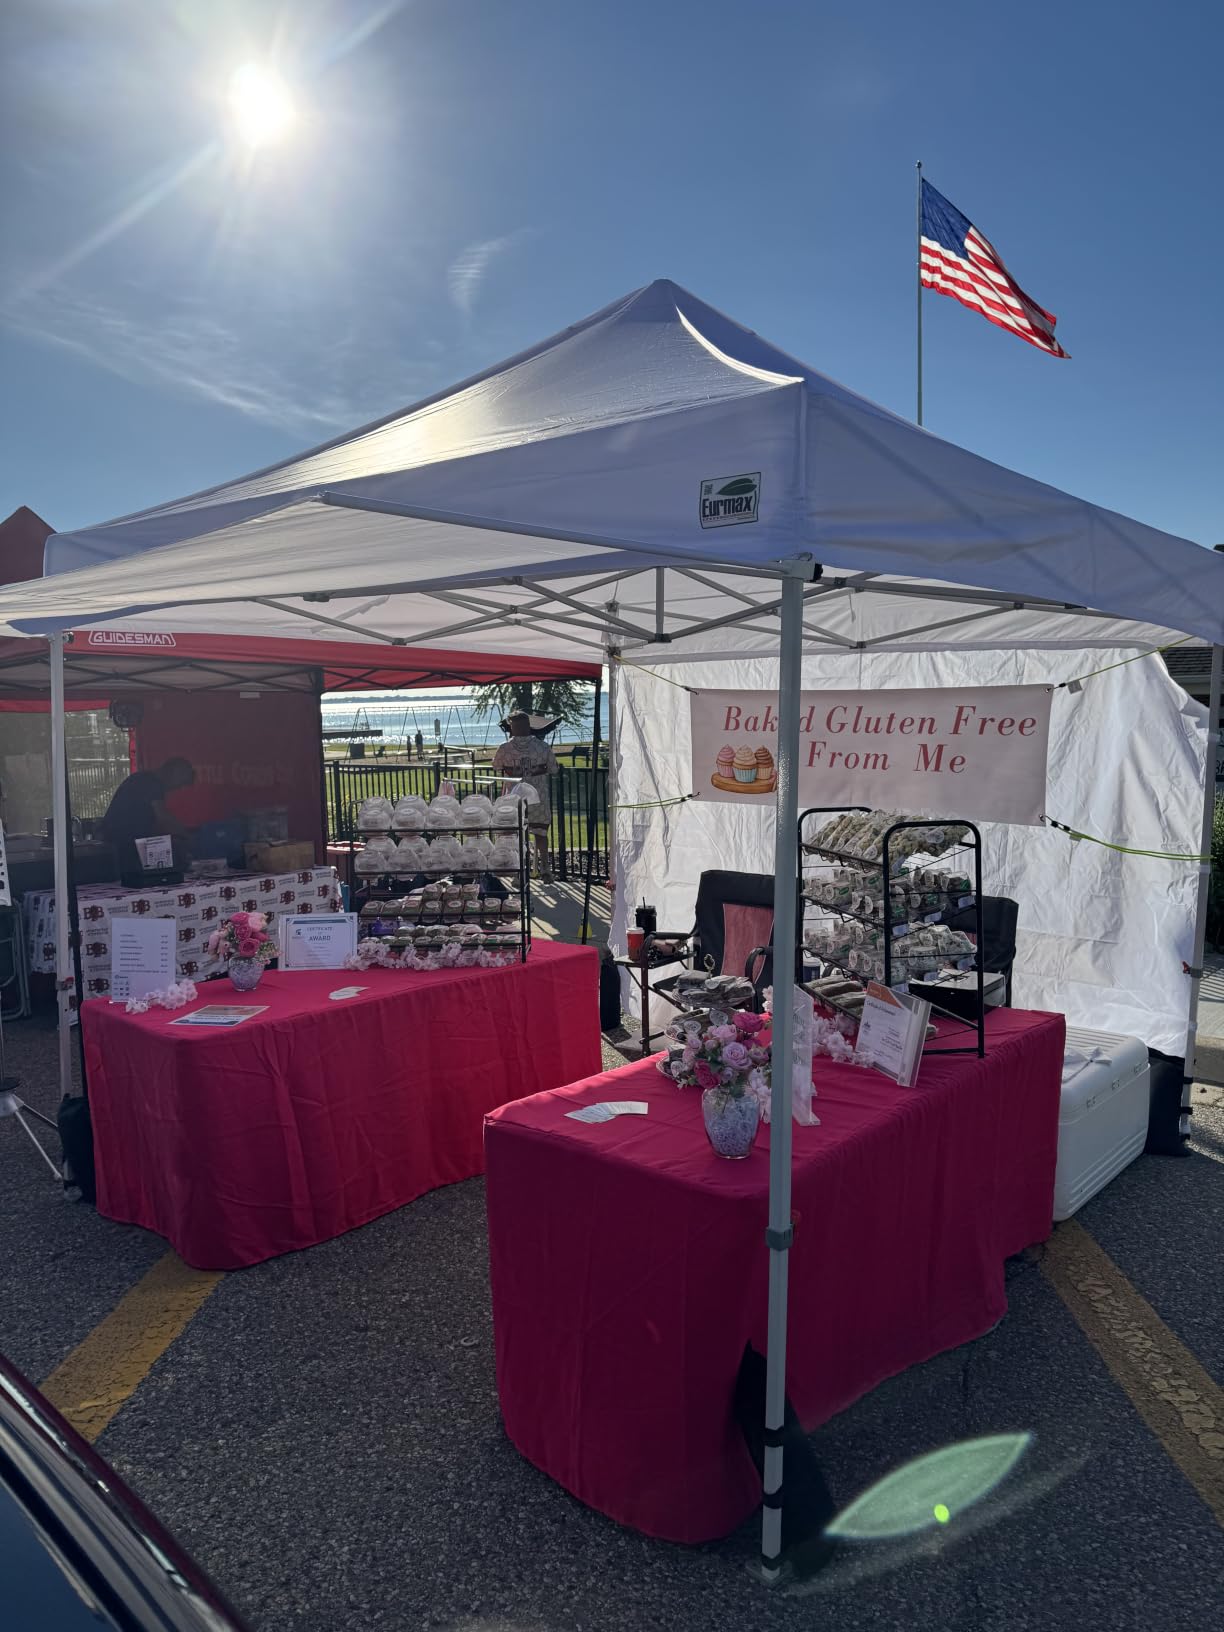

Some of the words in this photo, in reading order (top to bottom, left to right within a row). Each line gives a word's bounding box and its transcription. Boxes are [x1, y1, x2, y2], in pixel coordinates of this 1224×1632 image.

[702, 496, 753, 517] Eurmax
[93, 632, 172, 644] GUIDESMAN
[723, 705, 816, 732] Bakd
[826, 705, 937, 736] Gluten
[948, 705, 1037, 737] Free
[807, 740, 890, 770] From
[913, 743, 967, 773] Me
